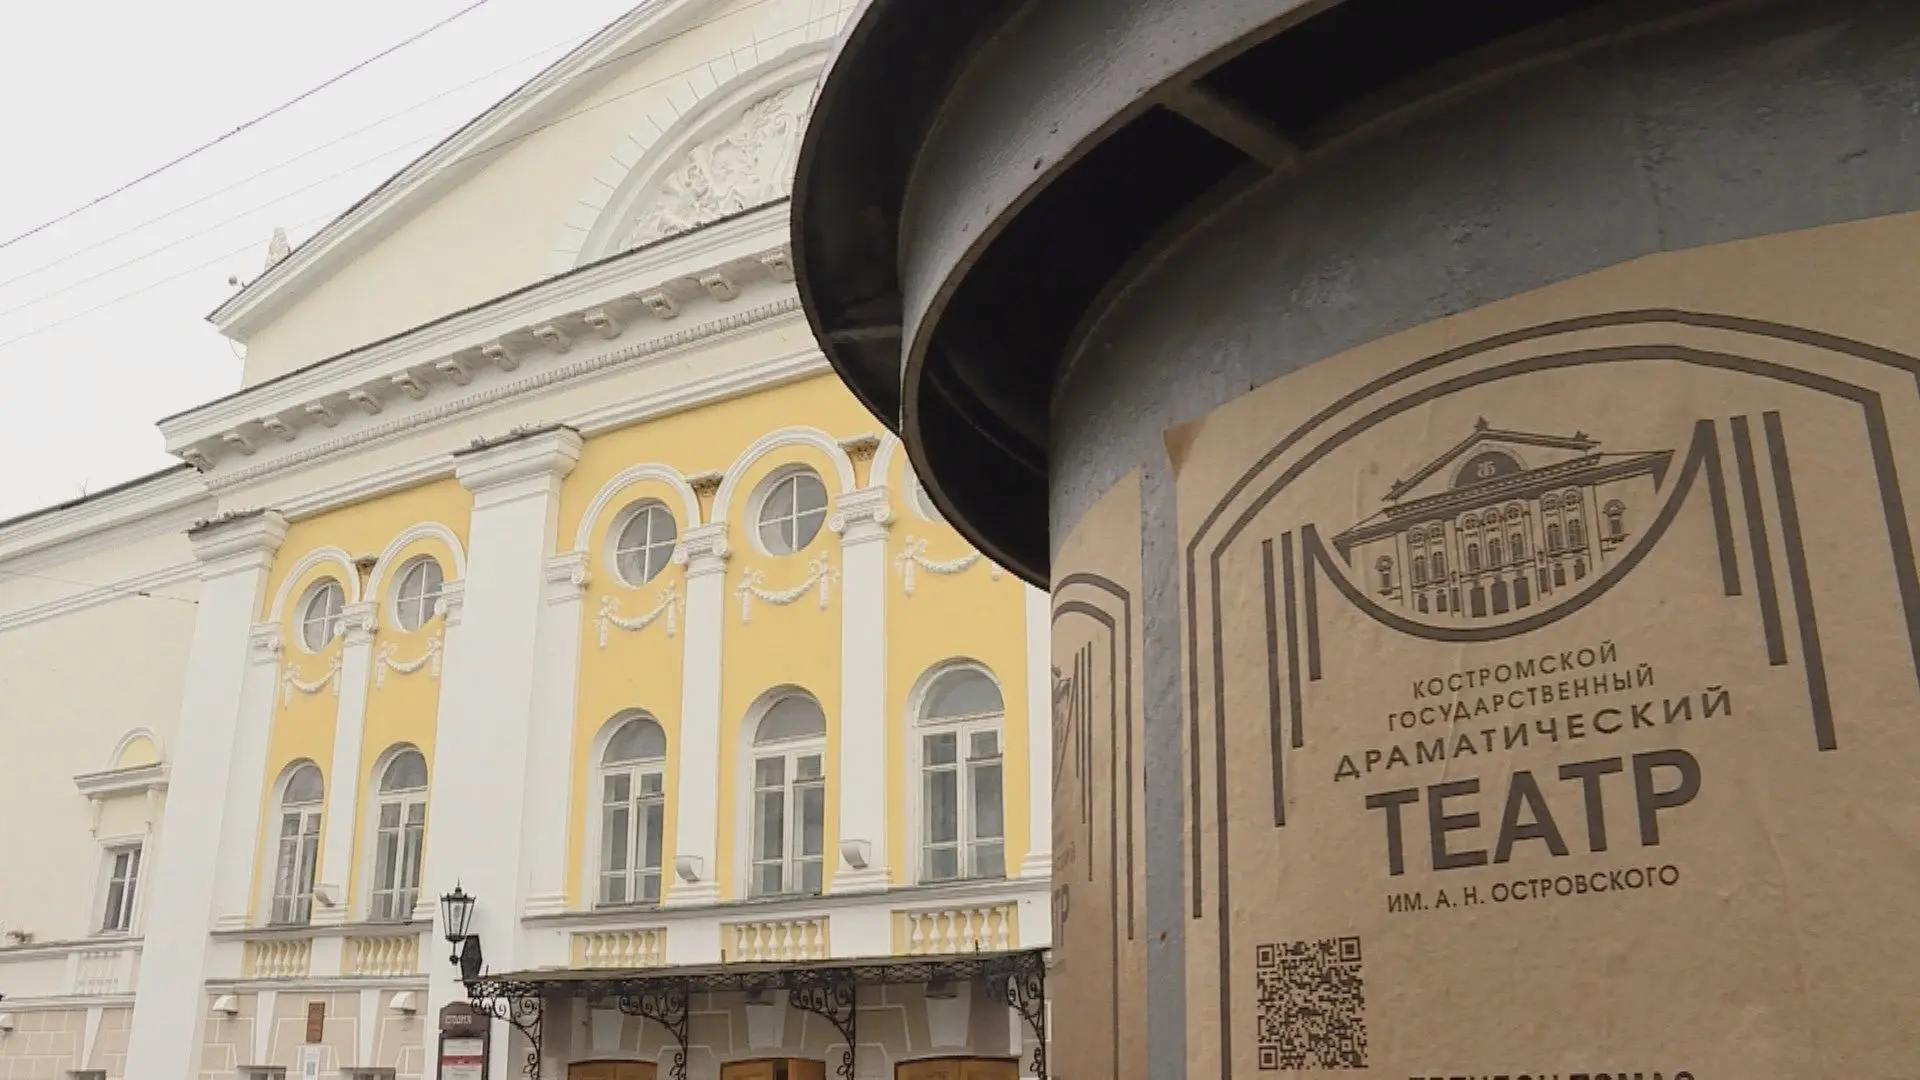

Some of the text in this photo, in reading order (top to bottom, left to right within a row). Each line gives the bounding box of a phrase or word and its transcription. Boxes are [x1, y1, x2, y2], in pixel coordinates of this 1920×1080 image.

[1388, 663, 1655, 732] ГОСУДАРСТВЕННЫЙ
[1412, 640, 1617, 699] КОСТРОМСКОЙ
[1333, 685, 1733, 782] ДРАМАТИЧЕСКИЙ
[1365, 748, 1702, 877] ТЕАТР
[1387, 890, 1429, 913] ИМ.
[1463, 885, 1486, 907] Н.
[1490, 864, 1680, 903] ОСТРОВСКОГО
